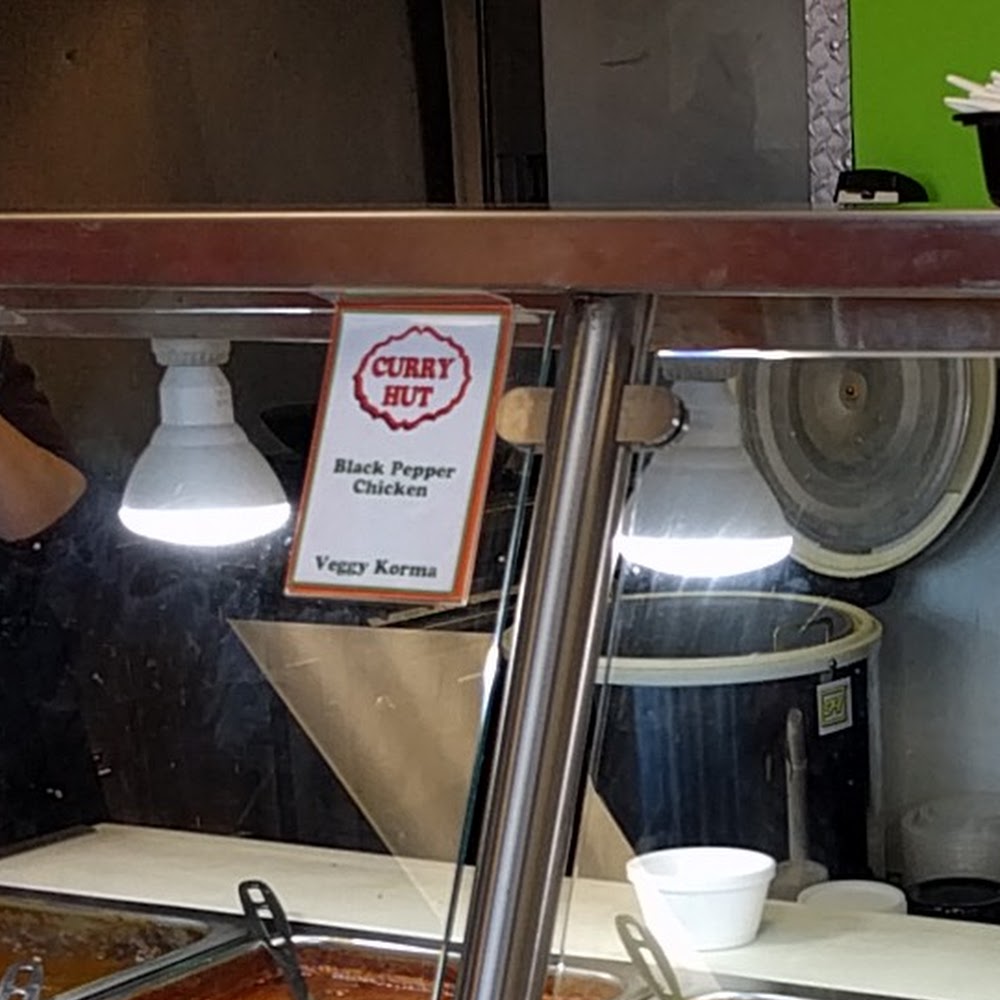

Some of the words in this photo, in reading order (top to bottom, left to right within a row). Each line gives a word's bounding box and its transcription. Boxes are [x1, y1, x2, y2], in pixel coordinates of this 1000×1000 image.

[372, 357, 455, 379] CURRY
[382, 385, 433, 407] HUT
[333, 459, 384, 475] Black
[391, 462, 456, 479] Pepper
[353, 479, 427, 497] Chicken
[315, 556, 369, 576] Veggy
[374, 559, 437, 577] Korma
